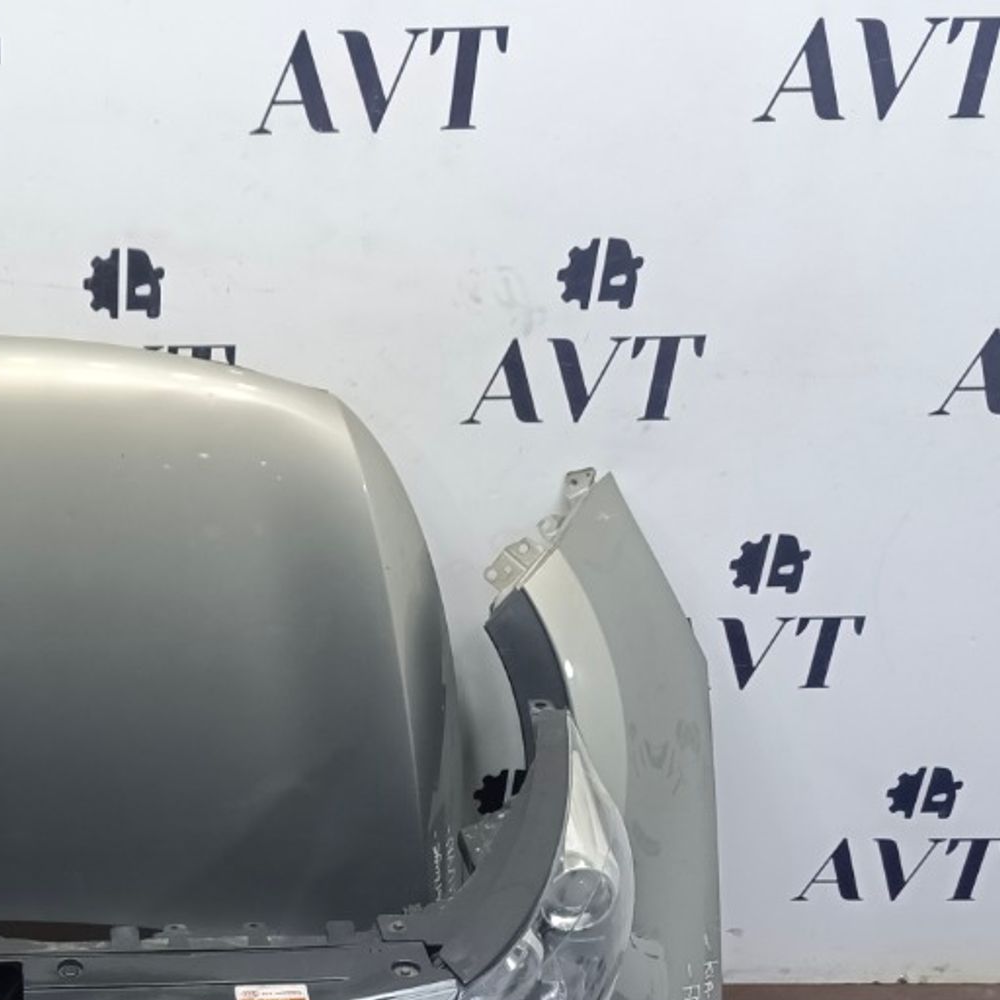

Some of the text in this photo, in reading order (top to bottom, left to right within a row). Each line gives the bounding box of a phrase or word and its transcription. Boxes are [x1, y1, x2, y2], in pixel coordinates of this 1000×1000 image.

[249, 26, 509, 134] AVT
[752, 17, 1000, 122] AVT
[460, 334, 706, 424] AVT
[716, 616, 866, 691] VT
[790, 837, 1000, 902] AVT
